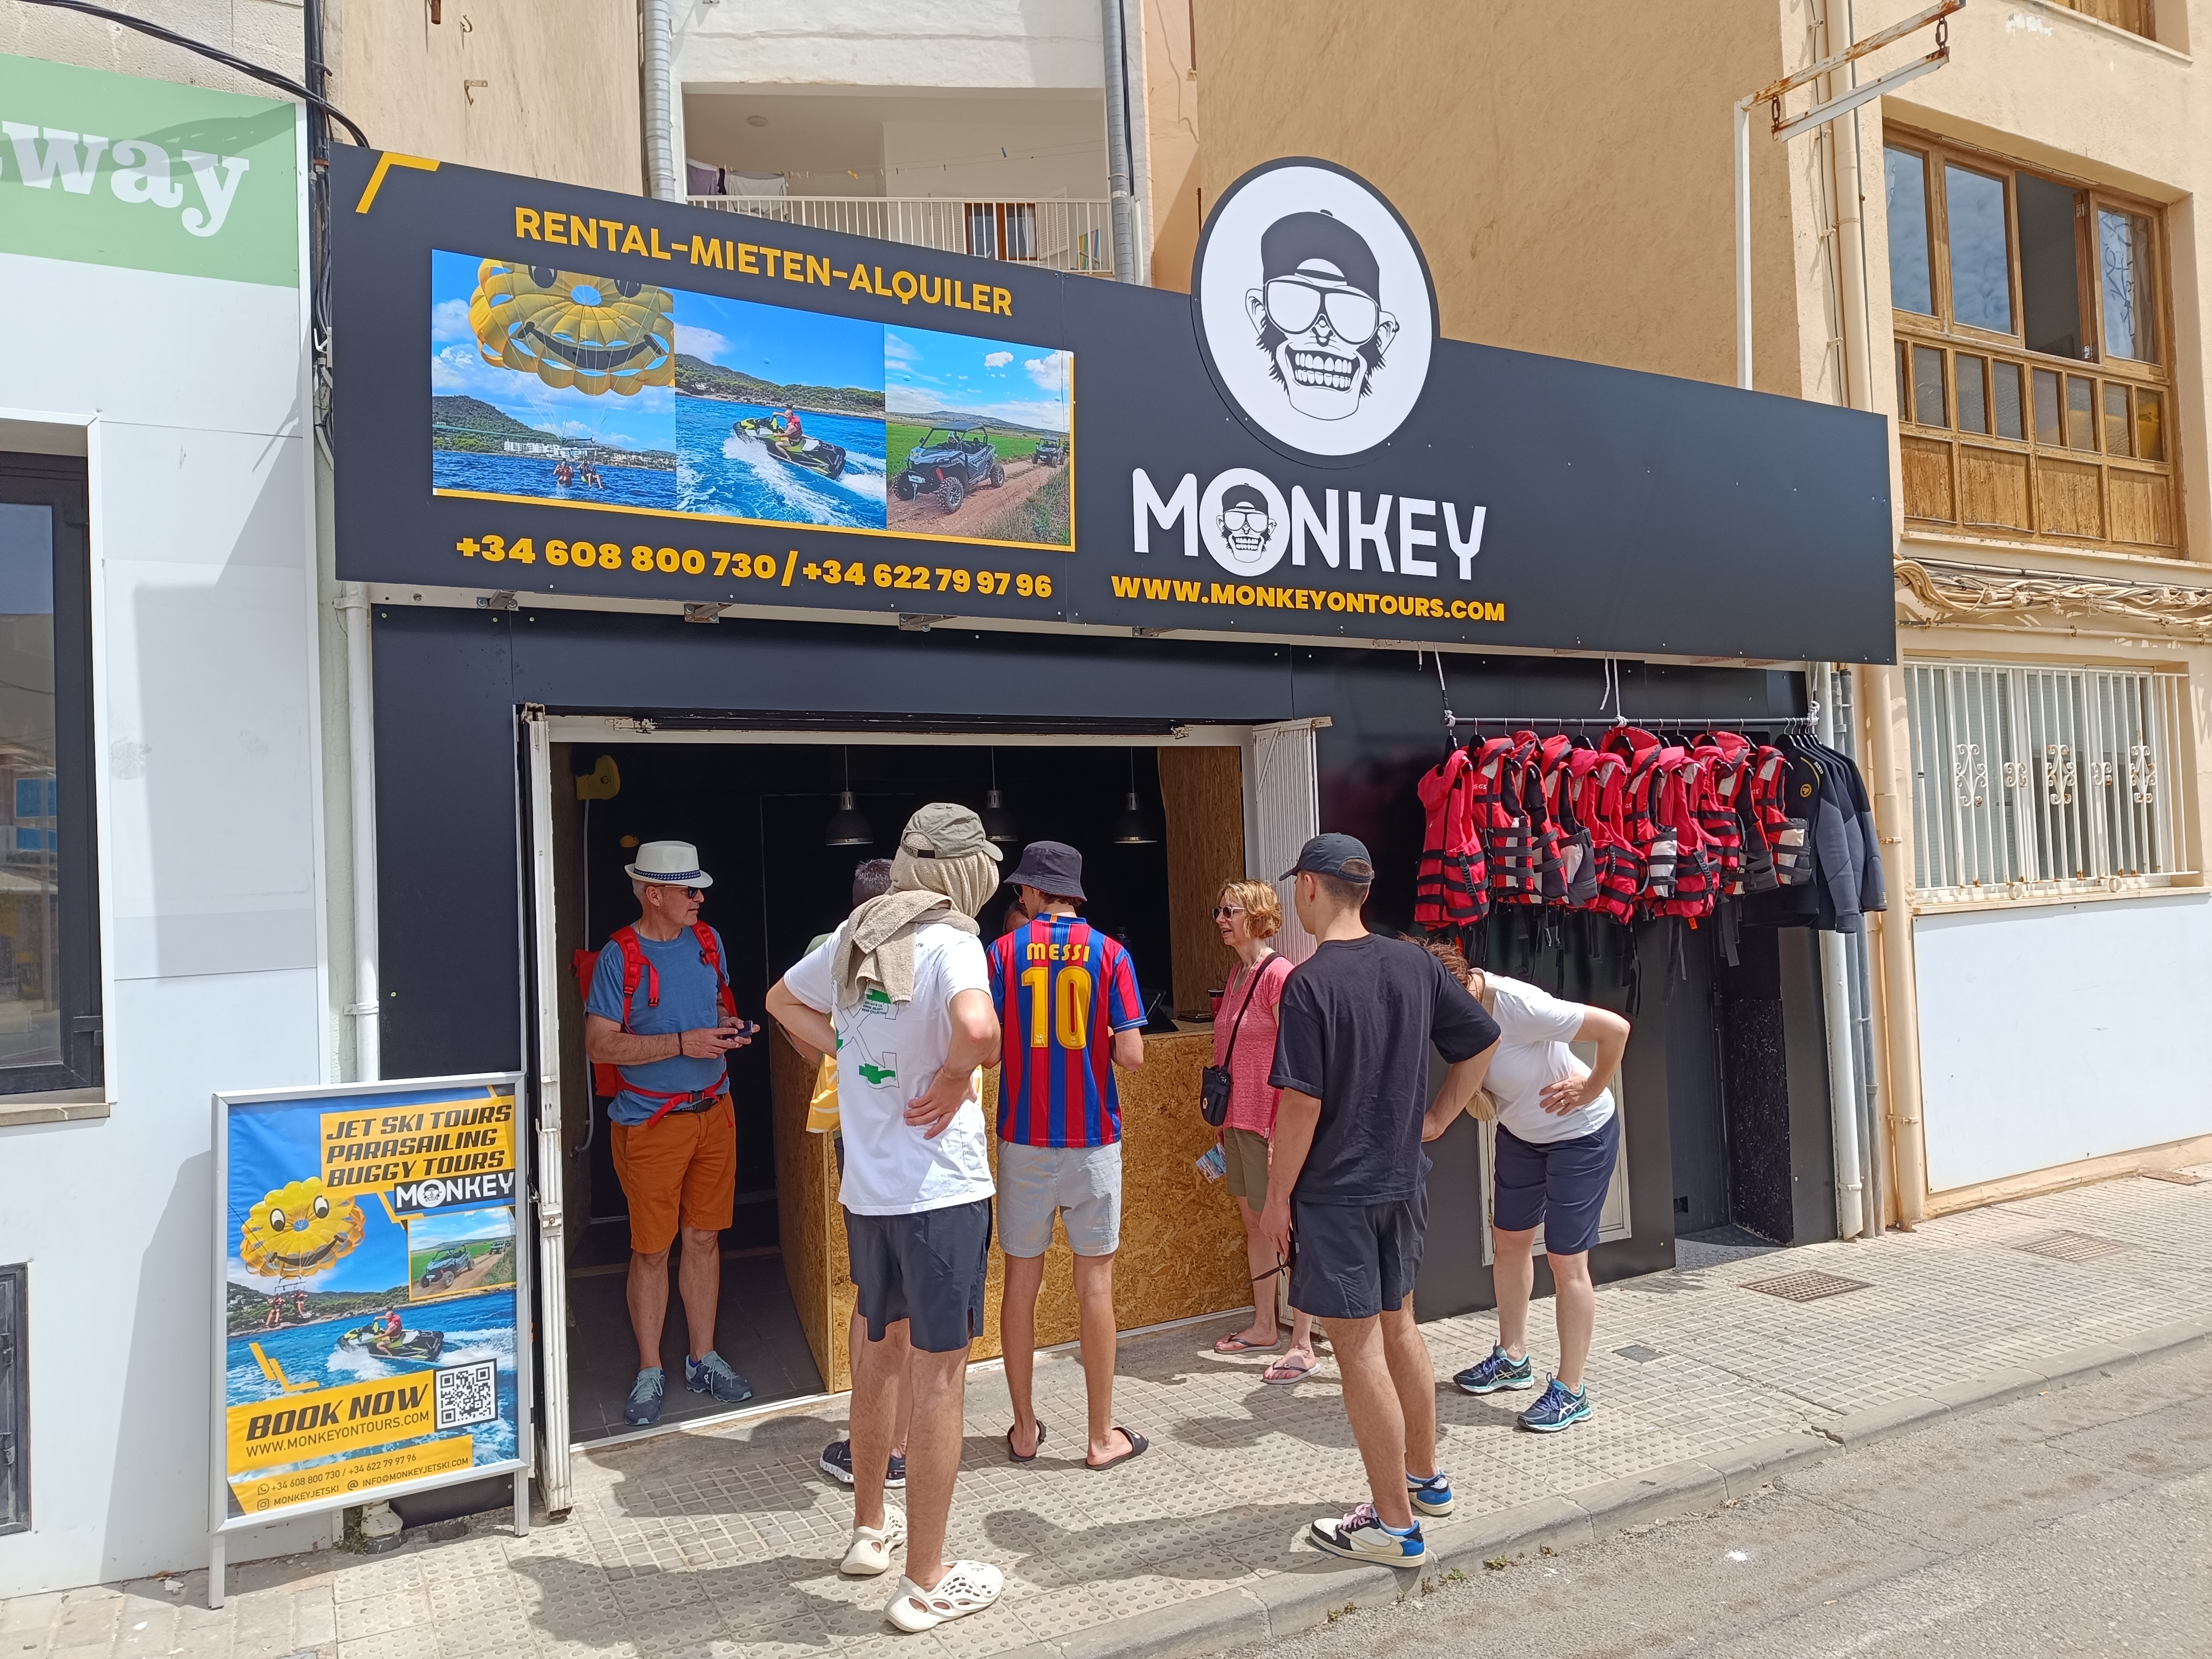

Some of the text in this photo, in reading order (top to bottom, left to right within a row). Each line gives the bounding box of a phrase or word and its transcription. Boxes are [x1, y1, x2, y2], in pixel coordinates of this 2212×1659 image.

[0, 120, 249, 237] way
[514, 206, 1013, 316] RENTAL-MIETEN-ALQUILER
[1132, 467, 1487, 581] MONKEY
[456, 535, 1052, 598] +34 608 800 730 / +34 622 79 97 96
[1110, 575, 1506, 622] WWW.MONKEYONTOURS.COM
[1027, 943, 1090, 962] MESSI
[1021, 966, 1091, 1050] 10
[326, 1104, 512, 1140] JET SKI TOURS
[326, 1128, 498, 1164] PARASAILING
[326, 1150, 505, 1189] BUGGY TOURS
[396, 1172, 515, 1209] MONKEY
[246, 1384, 429, 1442] BOOK NOW
[246, 1410, 430, 1458] WWW.MONKEYONTOURS.COM
[271, 1480, 287, 1493] +34
[289, 1476, 306, 1489] 608
[307, 1473, 323, 1486] 800
[325, 1469, 341, 1482] 730
[348, 1464, 365, 1476] +34
[366, 1460, 381, 1473] 622
[383, 1458, 394, 1469] 79
[395, 1455, 406, 1467] 97
[406, 1453, 417, 1465] 96
[273, 1485, 340, 1506] MONKEYJETSKI
[362, 1456, 469, 1487] INFO@MONKEYJETSKI.COM
